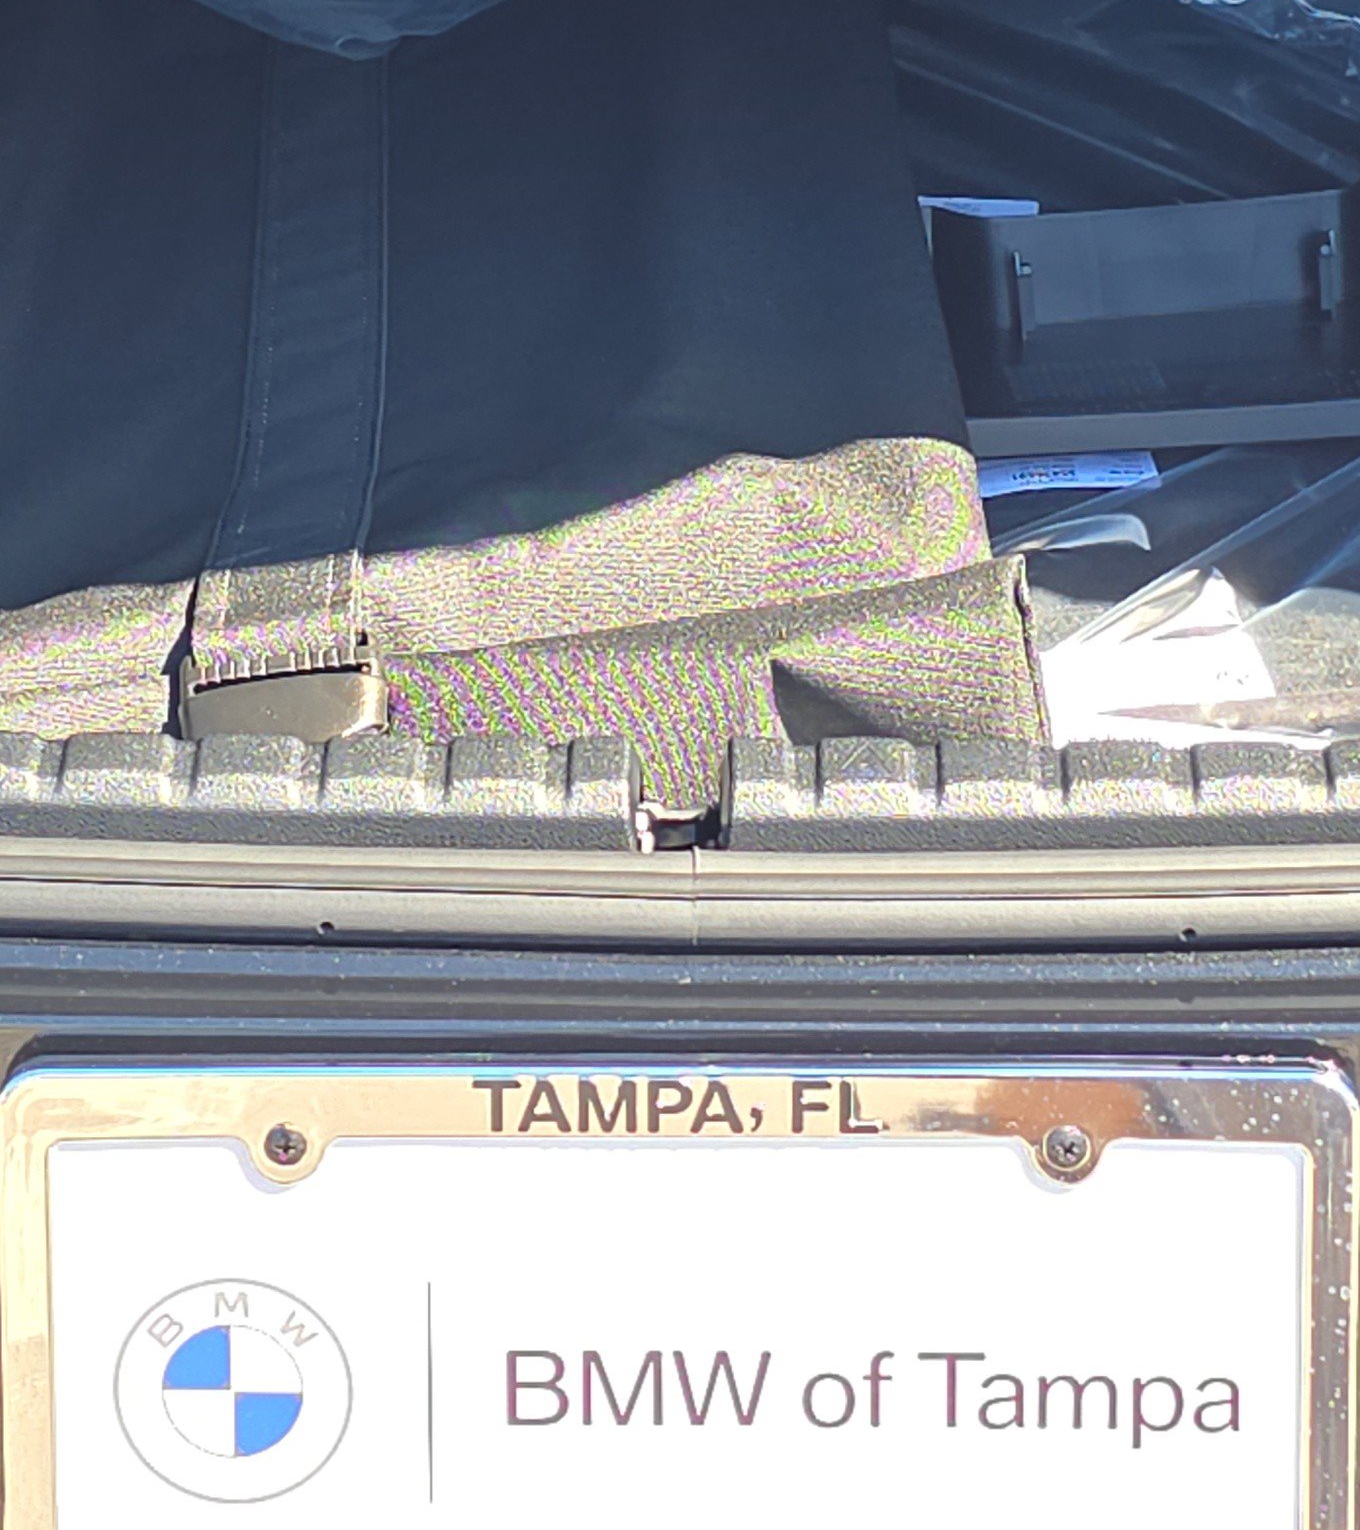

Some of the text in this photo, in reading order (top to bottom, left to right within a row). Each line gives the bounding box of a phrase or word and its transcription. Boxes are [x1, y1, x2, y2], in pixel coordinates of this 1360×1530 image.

[472, 1079, 885, 1134] TAMPA, FL
[146, 1291, 320, 1349] BMW
[505, 1349, 1242, 1450] BMW of Tampa
